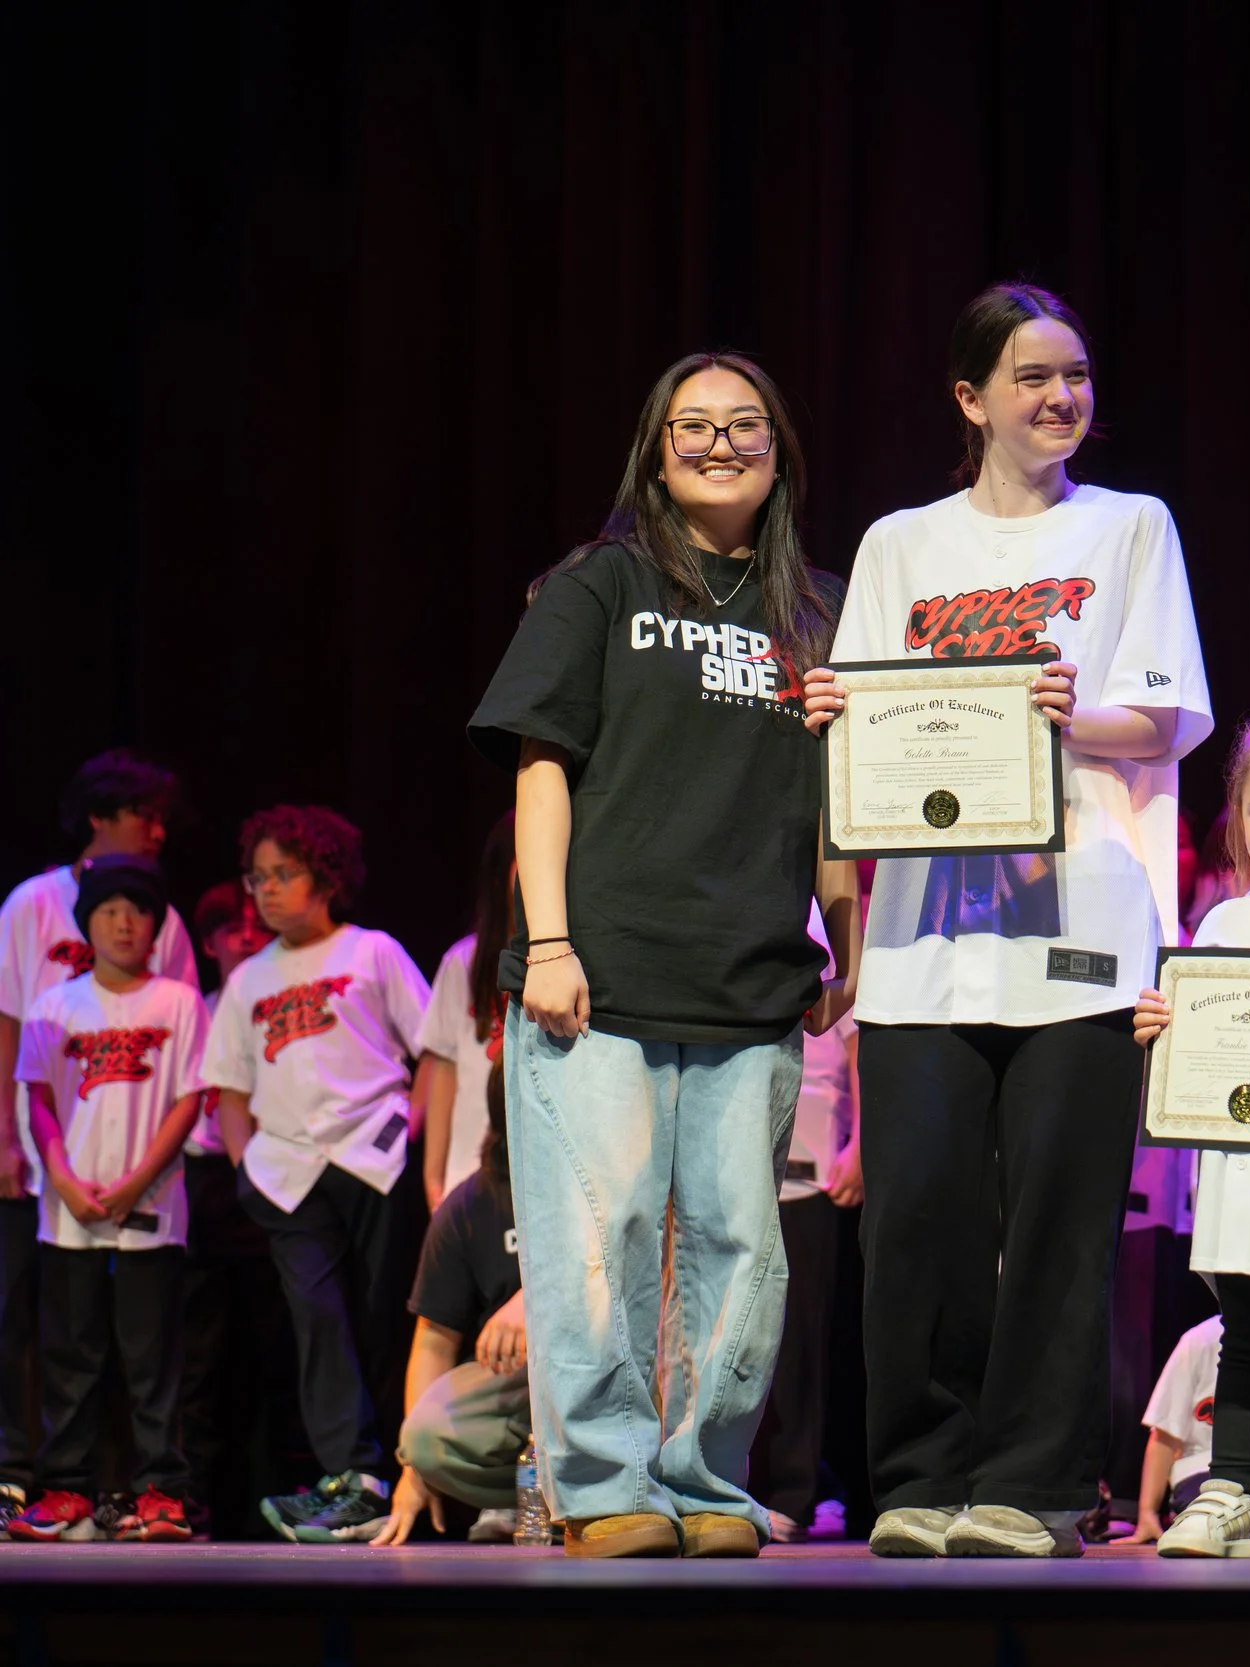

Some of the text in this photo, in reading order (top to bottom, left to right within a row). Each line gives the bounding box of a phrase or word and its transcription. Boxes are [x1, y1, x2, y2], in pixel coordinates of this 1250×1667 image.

[904, 577, 1096, 653] CYPHER
[631, 611, 774, 664] CYPHER
[701, 653, 779, 701] SIDE
[701, 691, 807, 721] DANCE SCHOO
[869, 699, 1005, 724] Certificate Of Excellence
[1190, 991, 1242, 1012] Certificate
